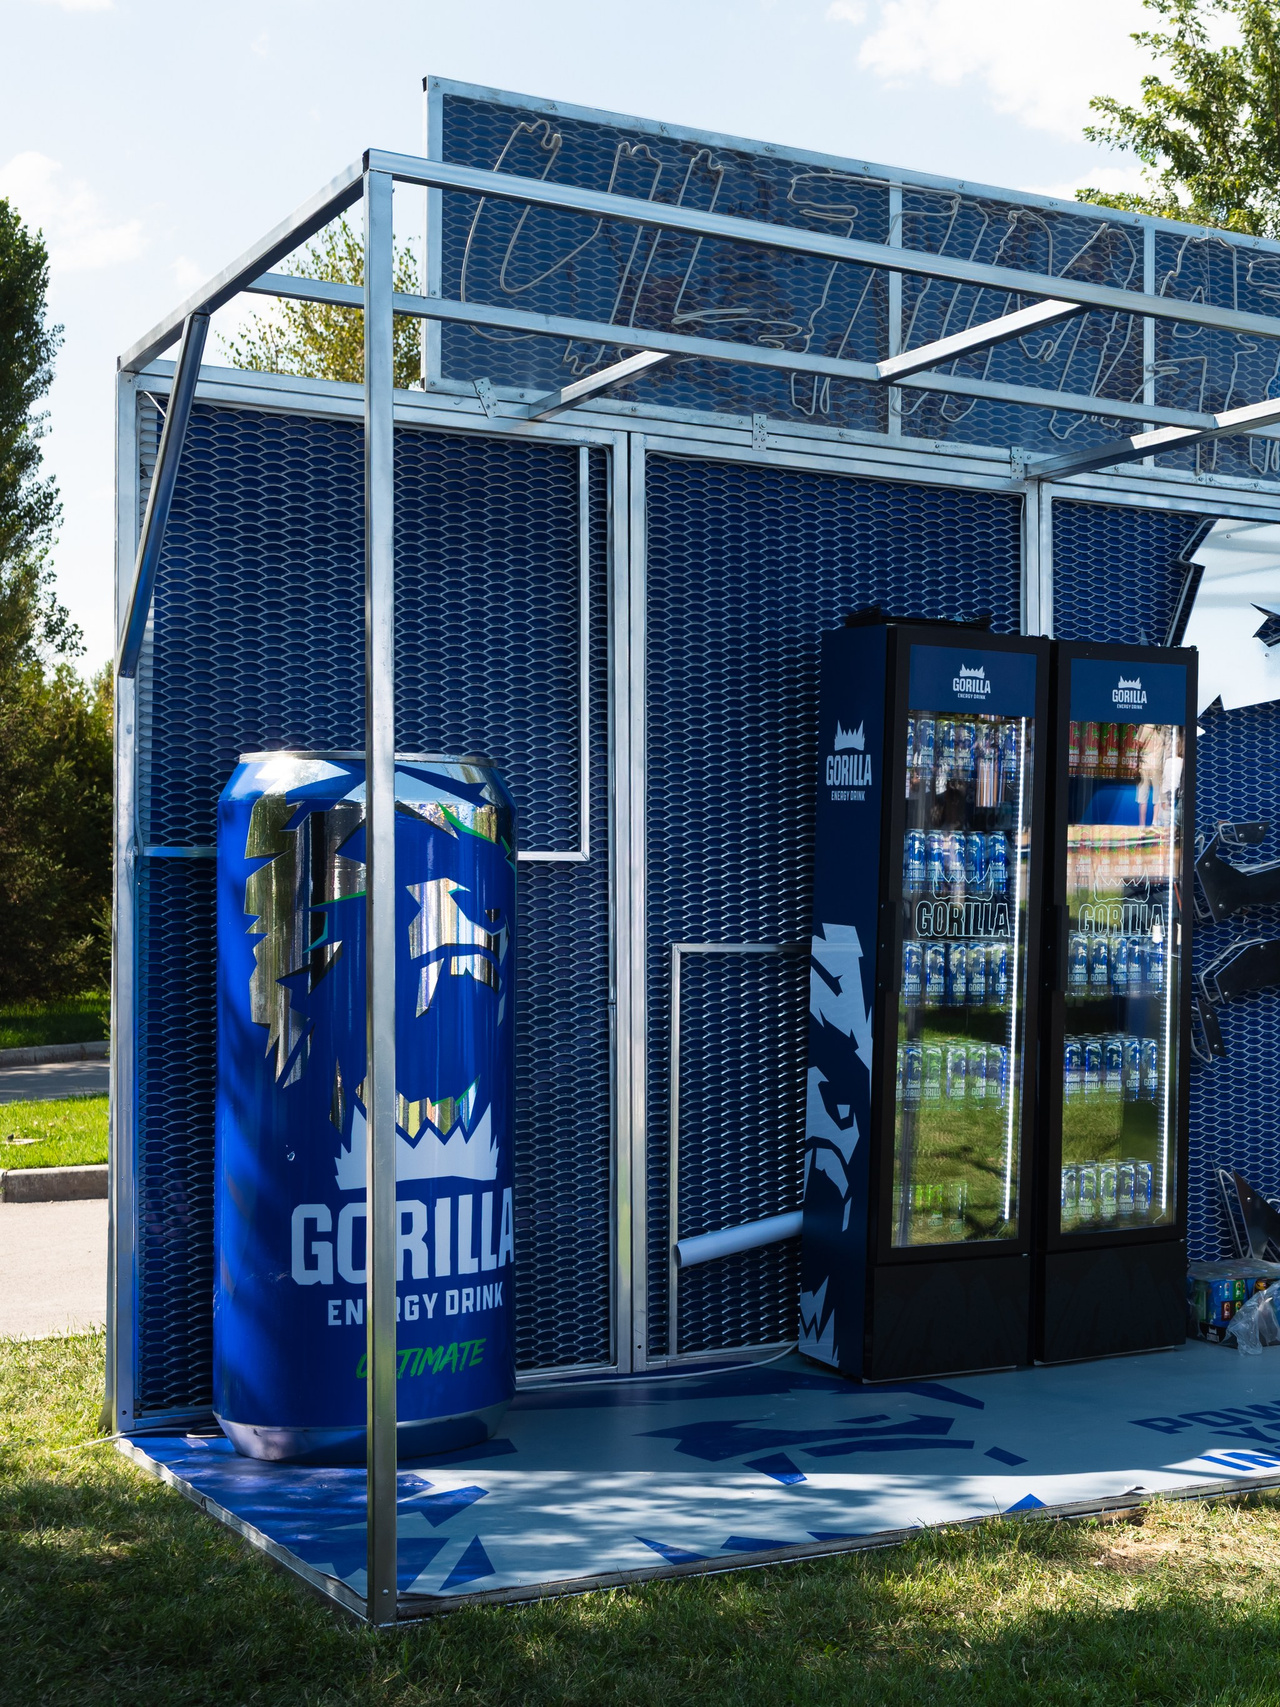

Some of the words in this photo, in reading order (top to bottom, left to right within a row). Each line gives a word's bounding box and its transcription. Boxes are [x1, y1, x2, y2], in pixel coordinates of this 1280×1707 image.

[952, 677, 991, 694] GORILLA
[1112, 689, 1148, 704] GORILLA
[826, 754, 872, 786] GORILLA
[831, 790, 850, 801] ENERGY
[850, 790, 866, 801] DRINK
[915, 900, 1011, 937] GORILLA
[1078, 903, 1166, 938] GORILLA
[291, 1187, 514, 1286] GORILLA
[328, 1293, 438, 1326] ENGY
[446, 1282, 503, 1316] DRINK
[356, 1338, 487, 1380] UTIMATE
